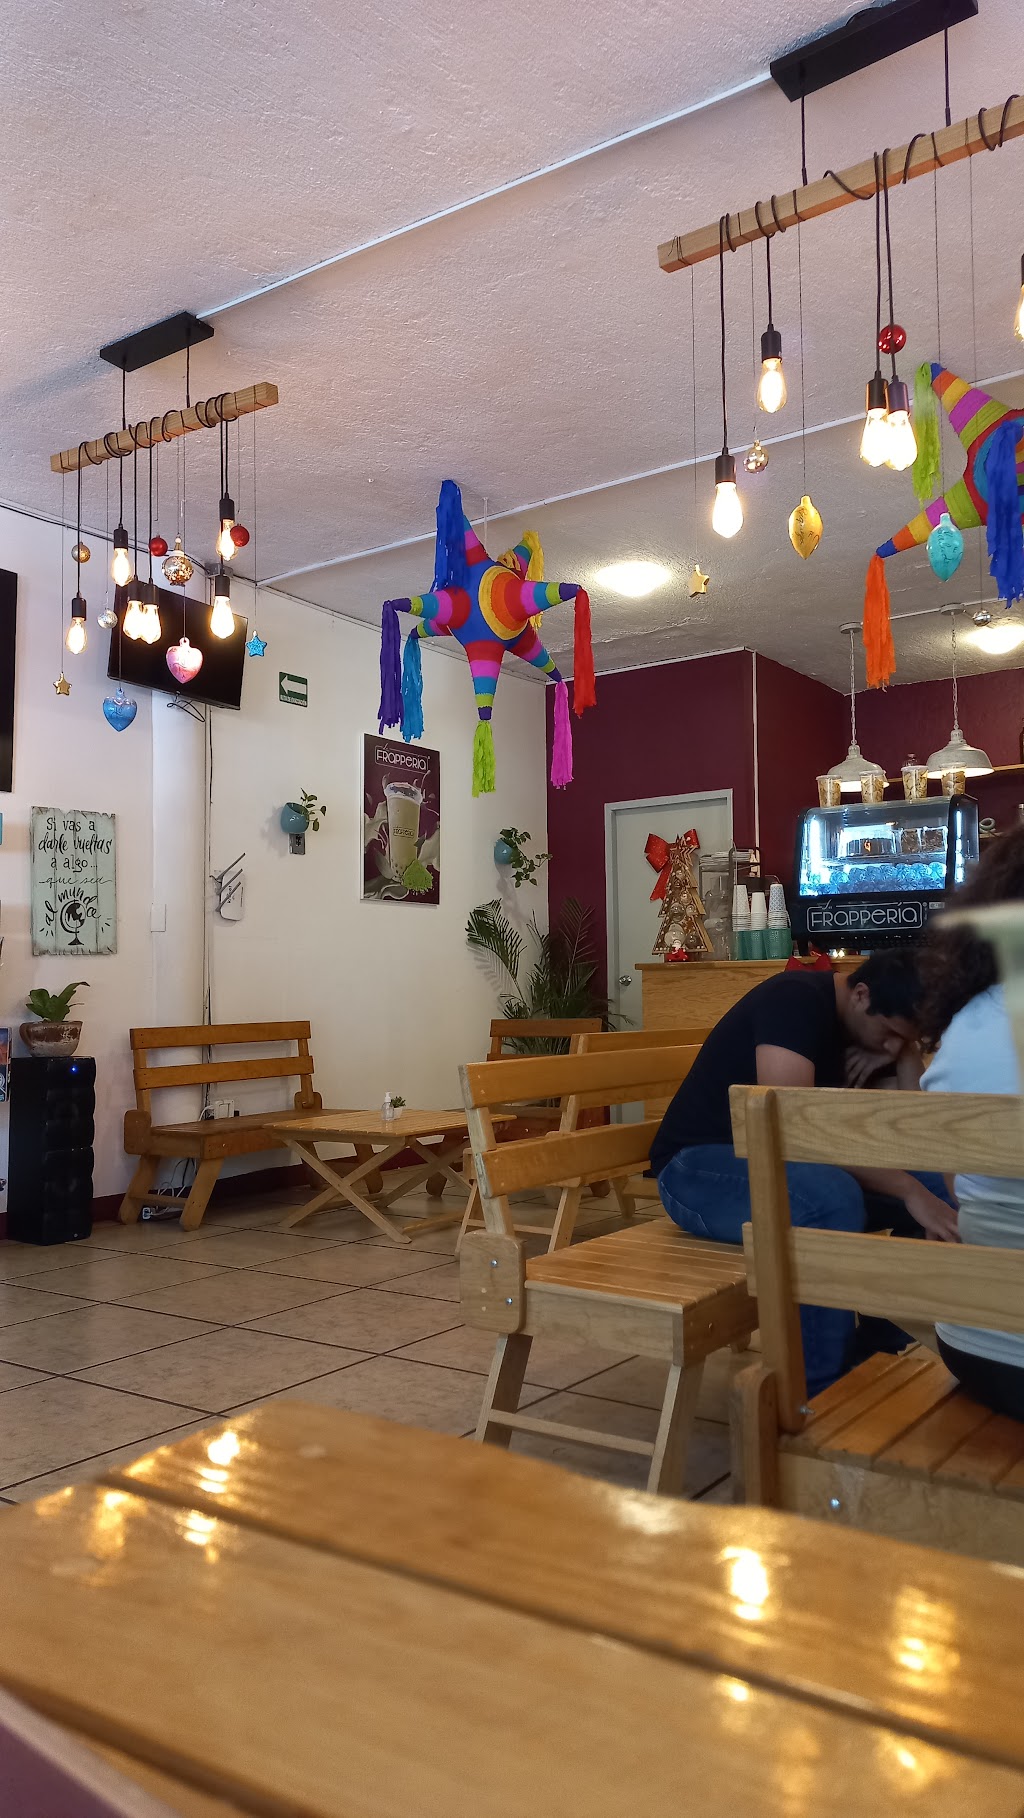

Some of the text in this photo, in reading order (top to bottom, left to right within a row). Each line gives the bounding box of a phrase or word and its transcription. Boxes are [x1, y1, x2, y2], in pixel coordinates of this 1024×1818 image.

[46, 817, 96, 832] Si vas a
[38, 832, 113, 856] darle vueltas
[50, 857, 58, 871] a
[38, 877, 113, 889] que sea
[45, 900, 58, 927] al
